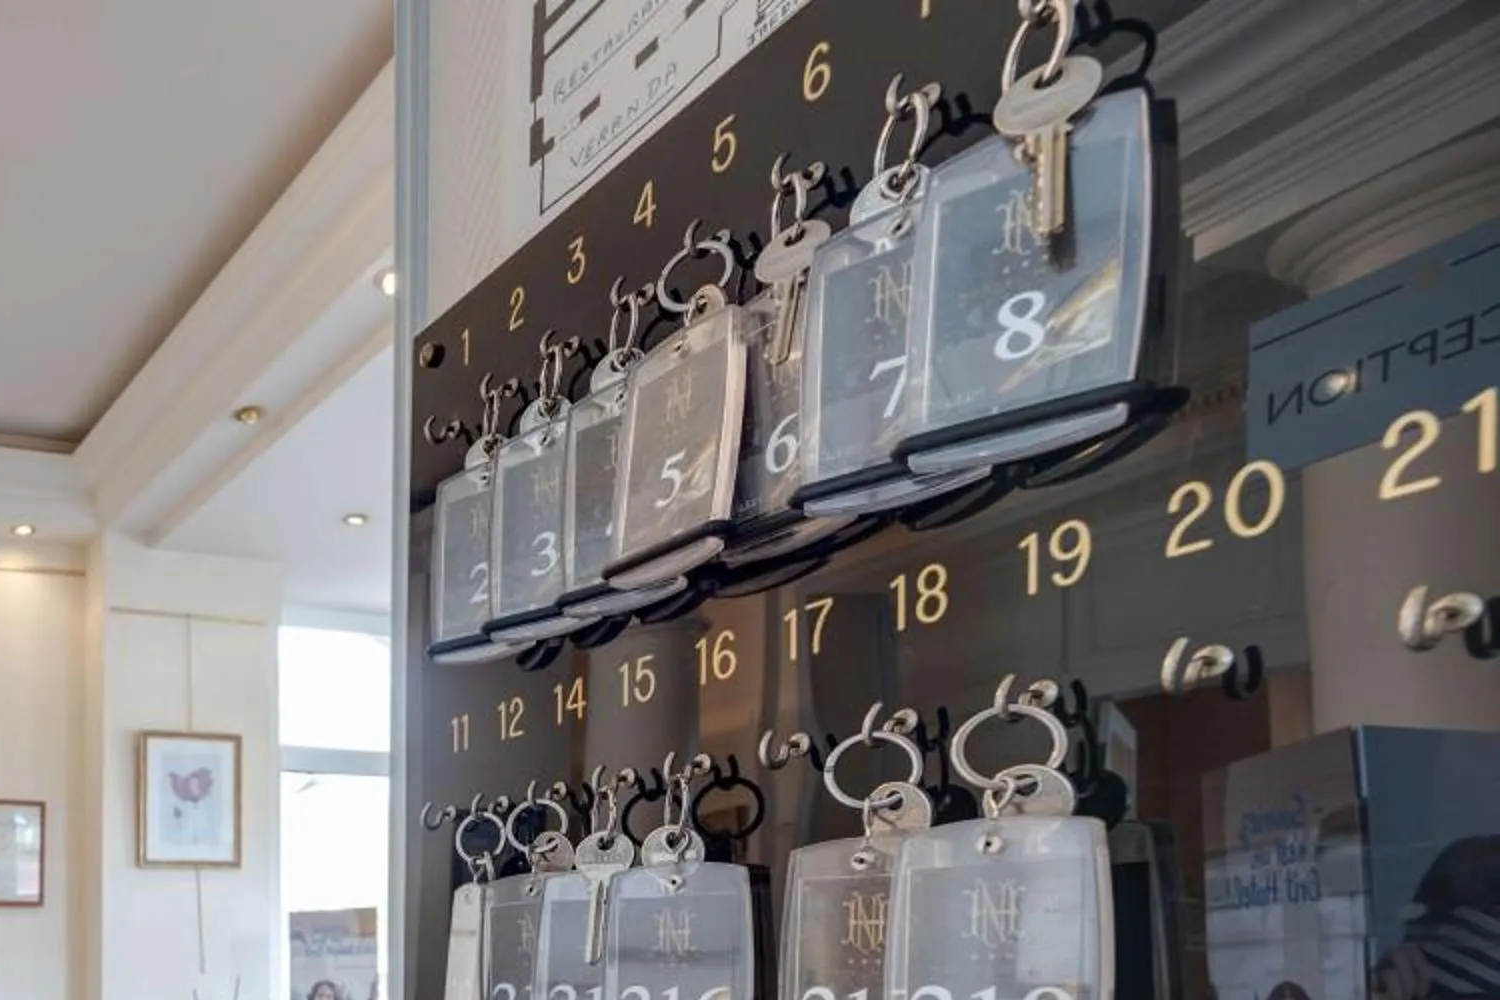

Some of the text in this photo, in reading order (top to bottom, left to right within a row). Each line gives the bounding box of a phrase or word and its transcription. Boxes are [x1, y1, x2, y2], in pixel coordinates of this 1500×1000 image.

[461, 41, 831, 366] 1 2 3 4 5 6
[994, 290, 1047, 361] 8
[869, 355, 907, 418] 7
[765, 412, 799, 473] 6
[655, 450, 685, 508] 5
[450, 386, 1498, 753] 11 12 14 15 16 17 18 19 20 21
[531, 531, 560, 576] 3
